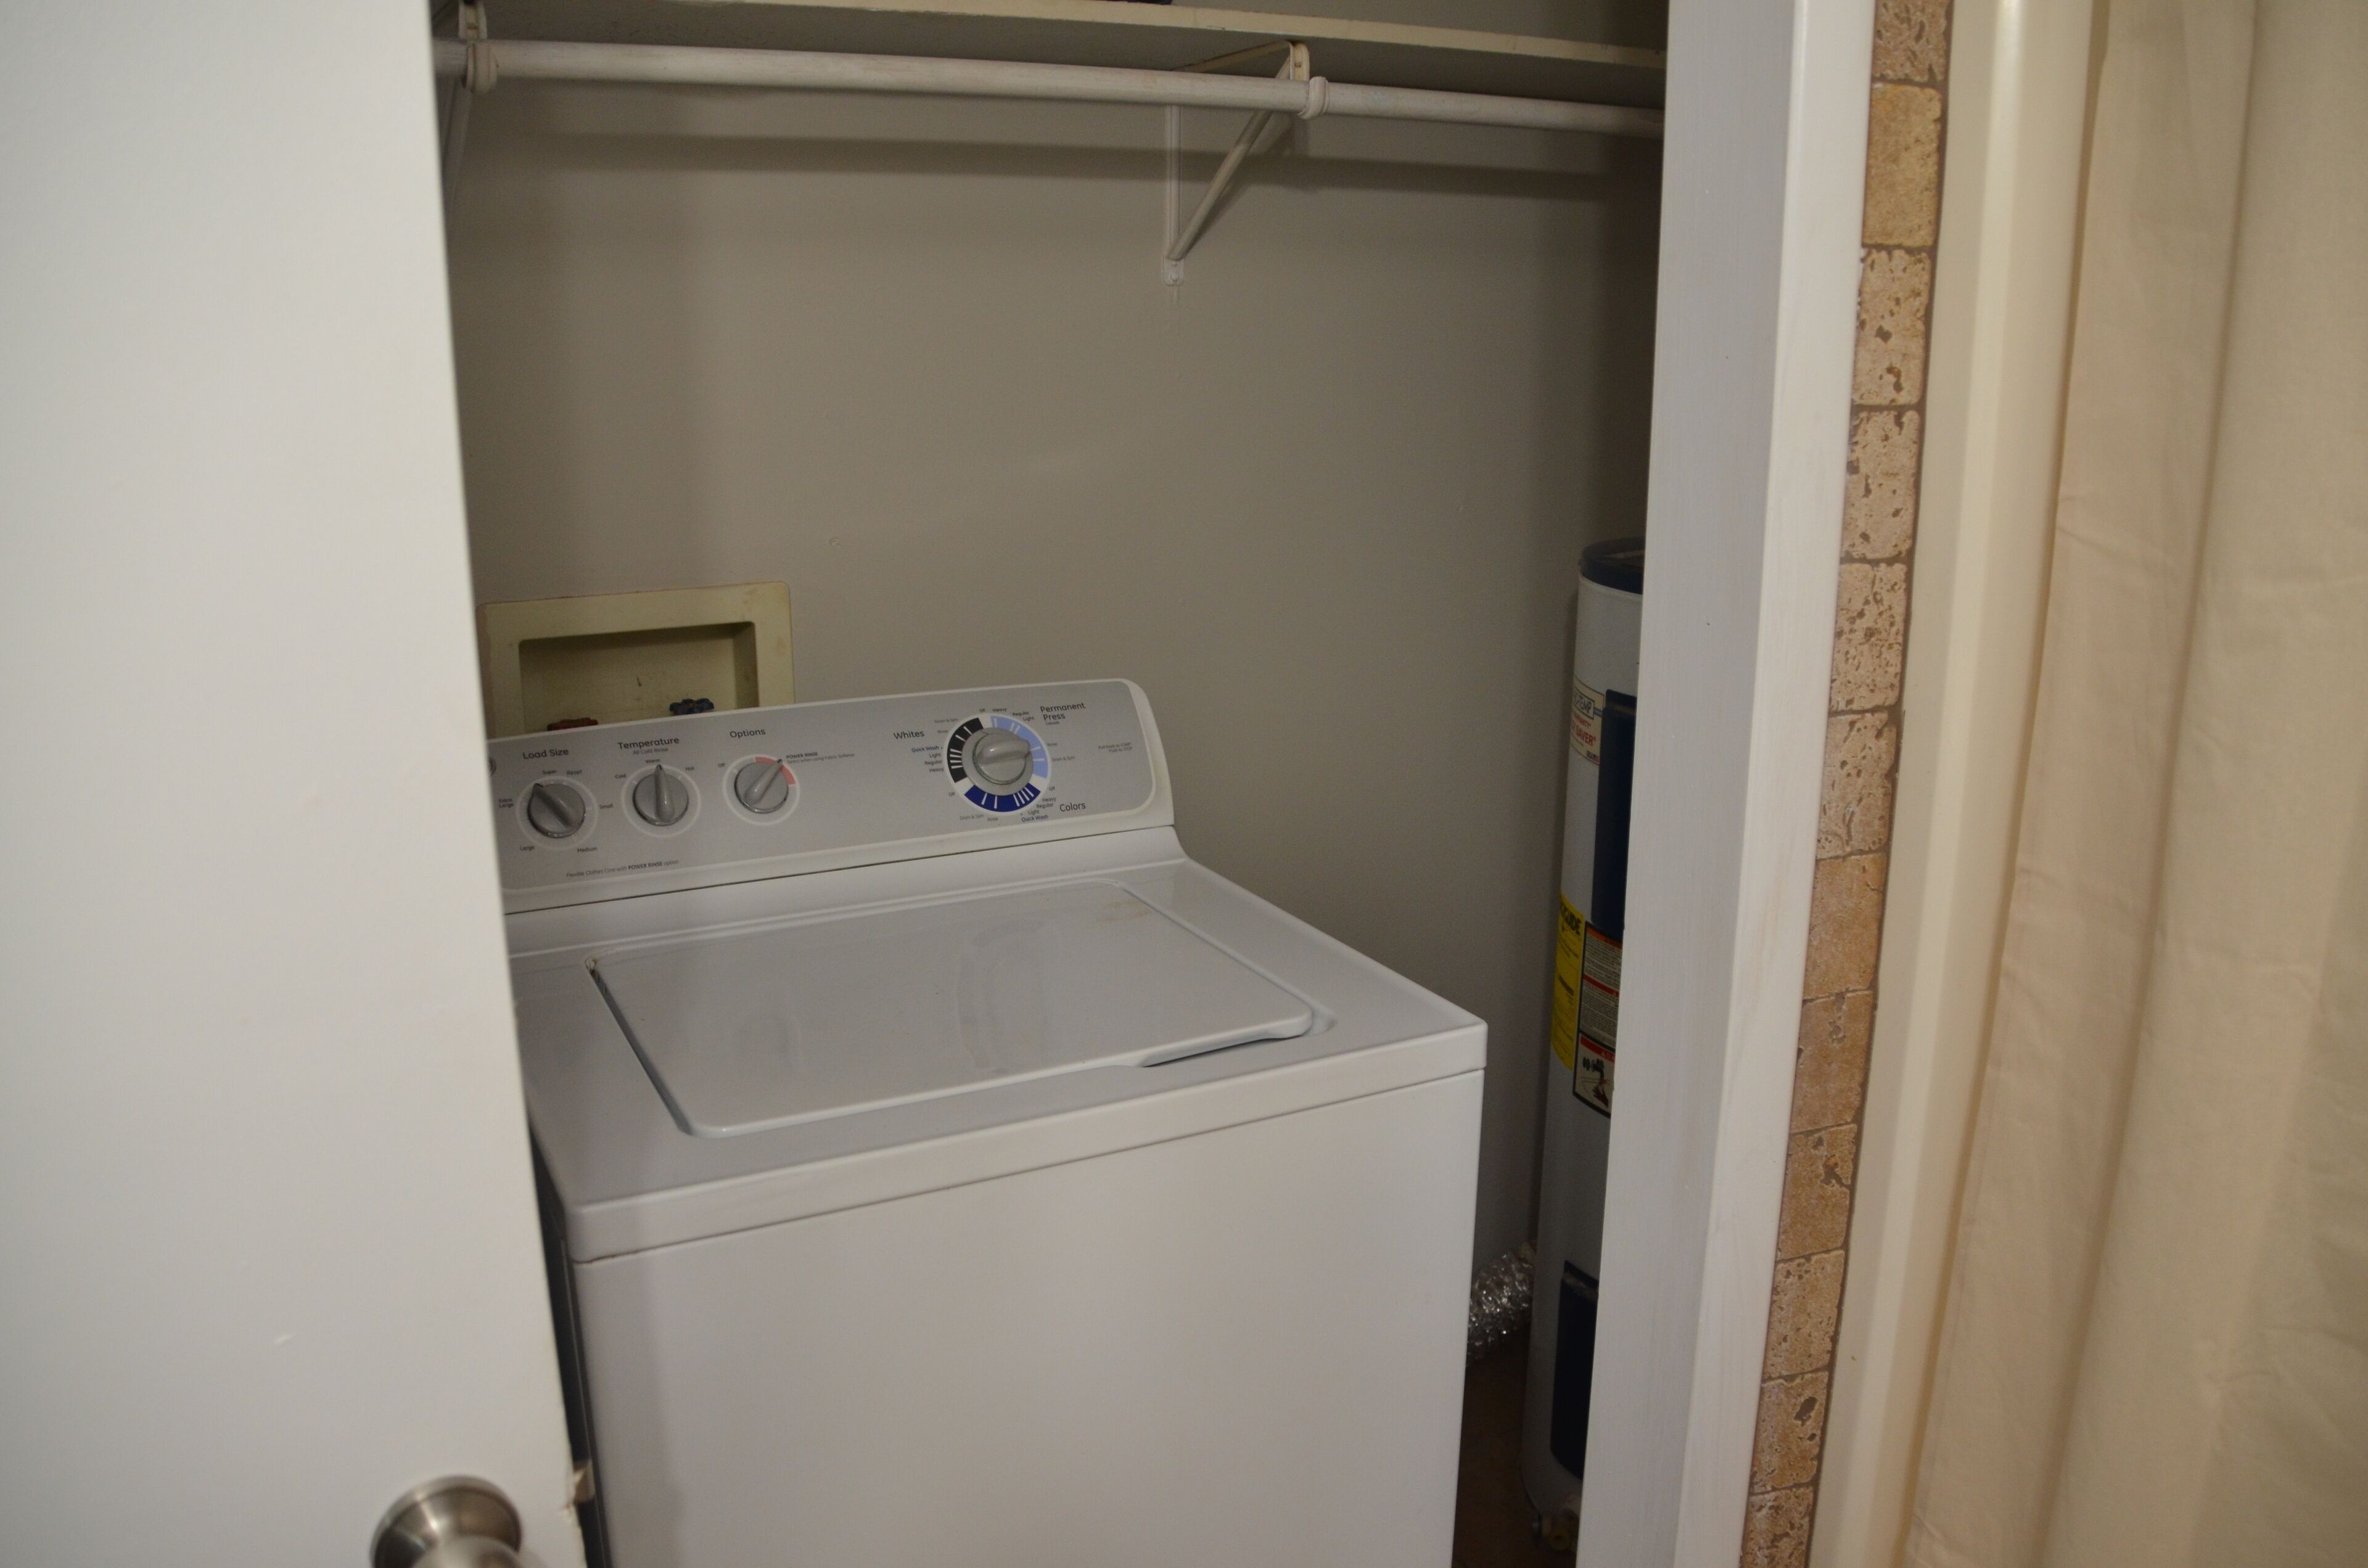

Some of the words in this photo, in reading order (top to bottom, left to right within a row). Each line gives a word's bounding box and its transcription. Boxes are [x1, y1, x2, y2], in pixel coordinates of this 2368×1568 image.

[1040, 703, 1085, 713] Permanent
[1043, 713, 1066, 721] Press
[730, 728, 766, 739] Options
[894, 731, 924, 739] Whites
[617, 737, 680, 749] Temperature
[523, 750, 546, 760] Load
[549, 749, 569, 757] Size
[1059, 802, 1086, 812] Colors
